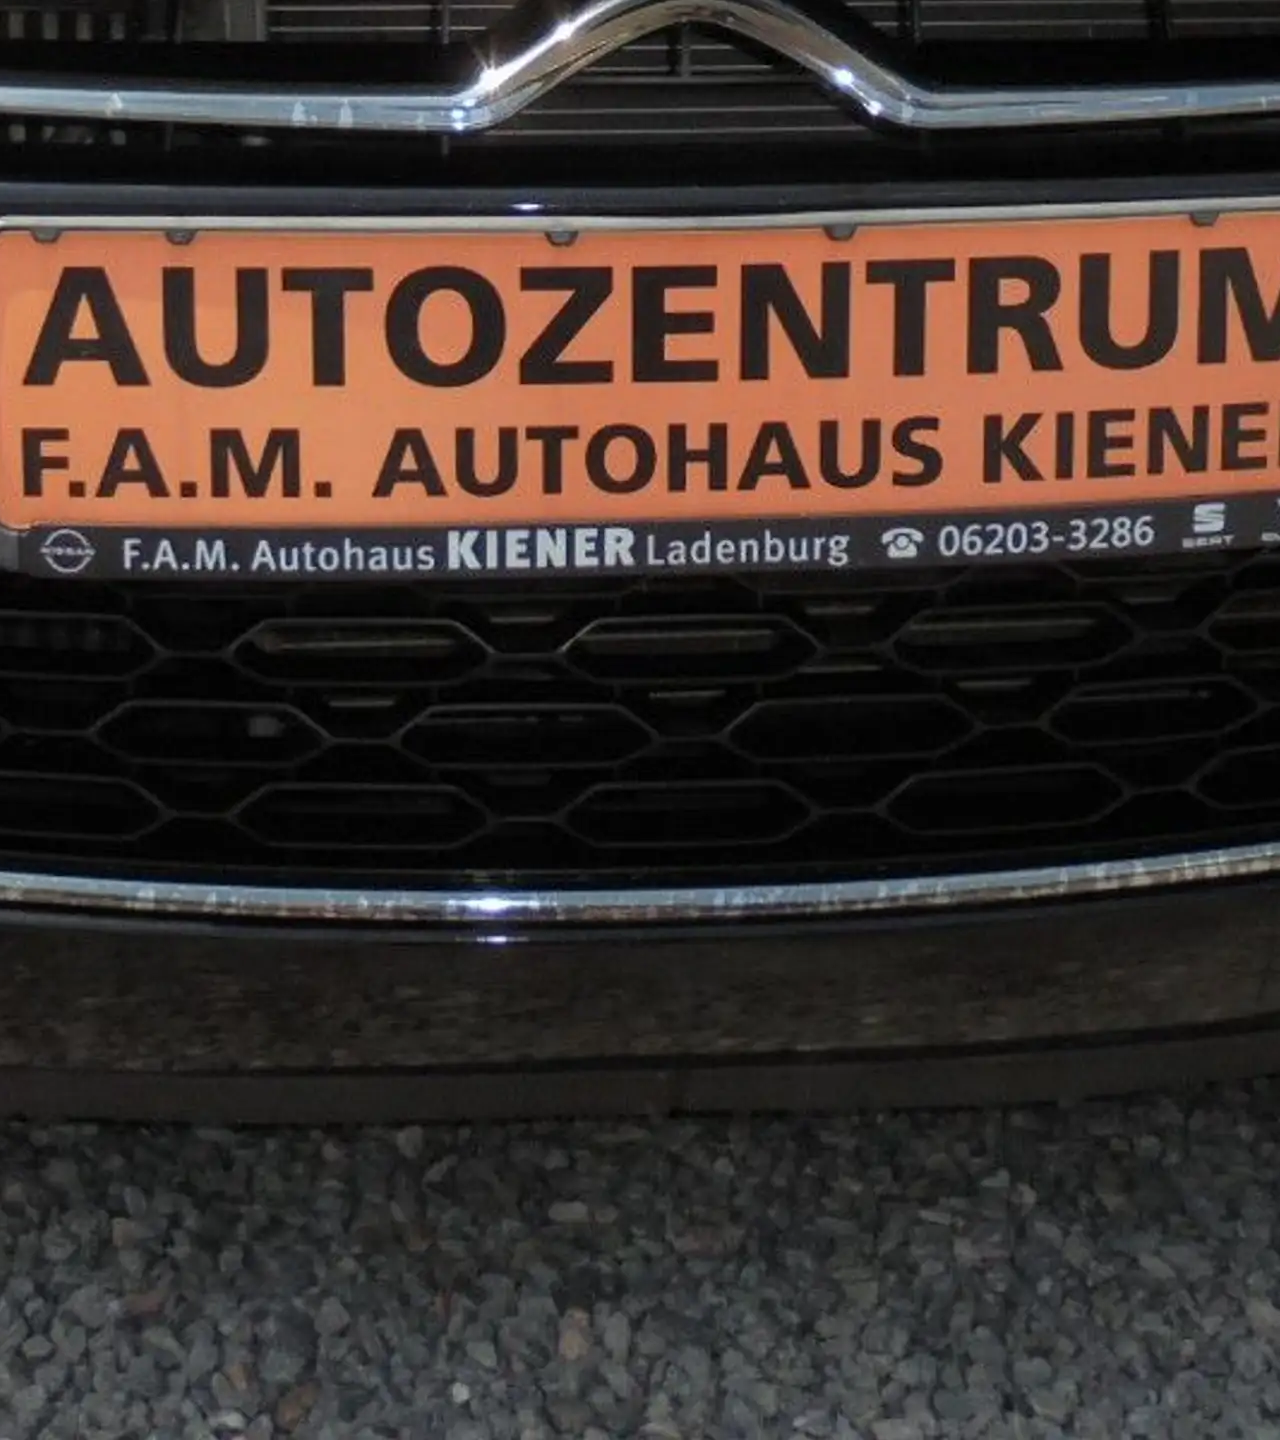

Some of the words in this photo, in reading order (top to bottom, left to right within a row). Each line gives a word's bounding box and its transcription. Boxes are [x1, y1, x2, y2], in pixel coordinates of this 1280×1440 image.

[22, 427, 333, 499] F.A.M.
[372, 416, 943, 498] AUTOHAUS
[123, 541, 240, 572] F.A.M.
[251, 537, 435, 572] Autohaus
[447, 527, 635, 570] KIENER
[647, 528, 851, 567] Ladenburg
[938, 515, 1156, 557] 06203-3286
